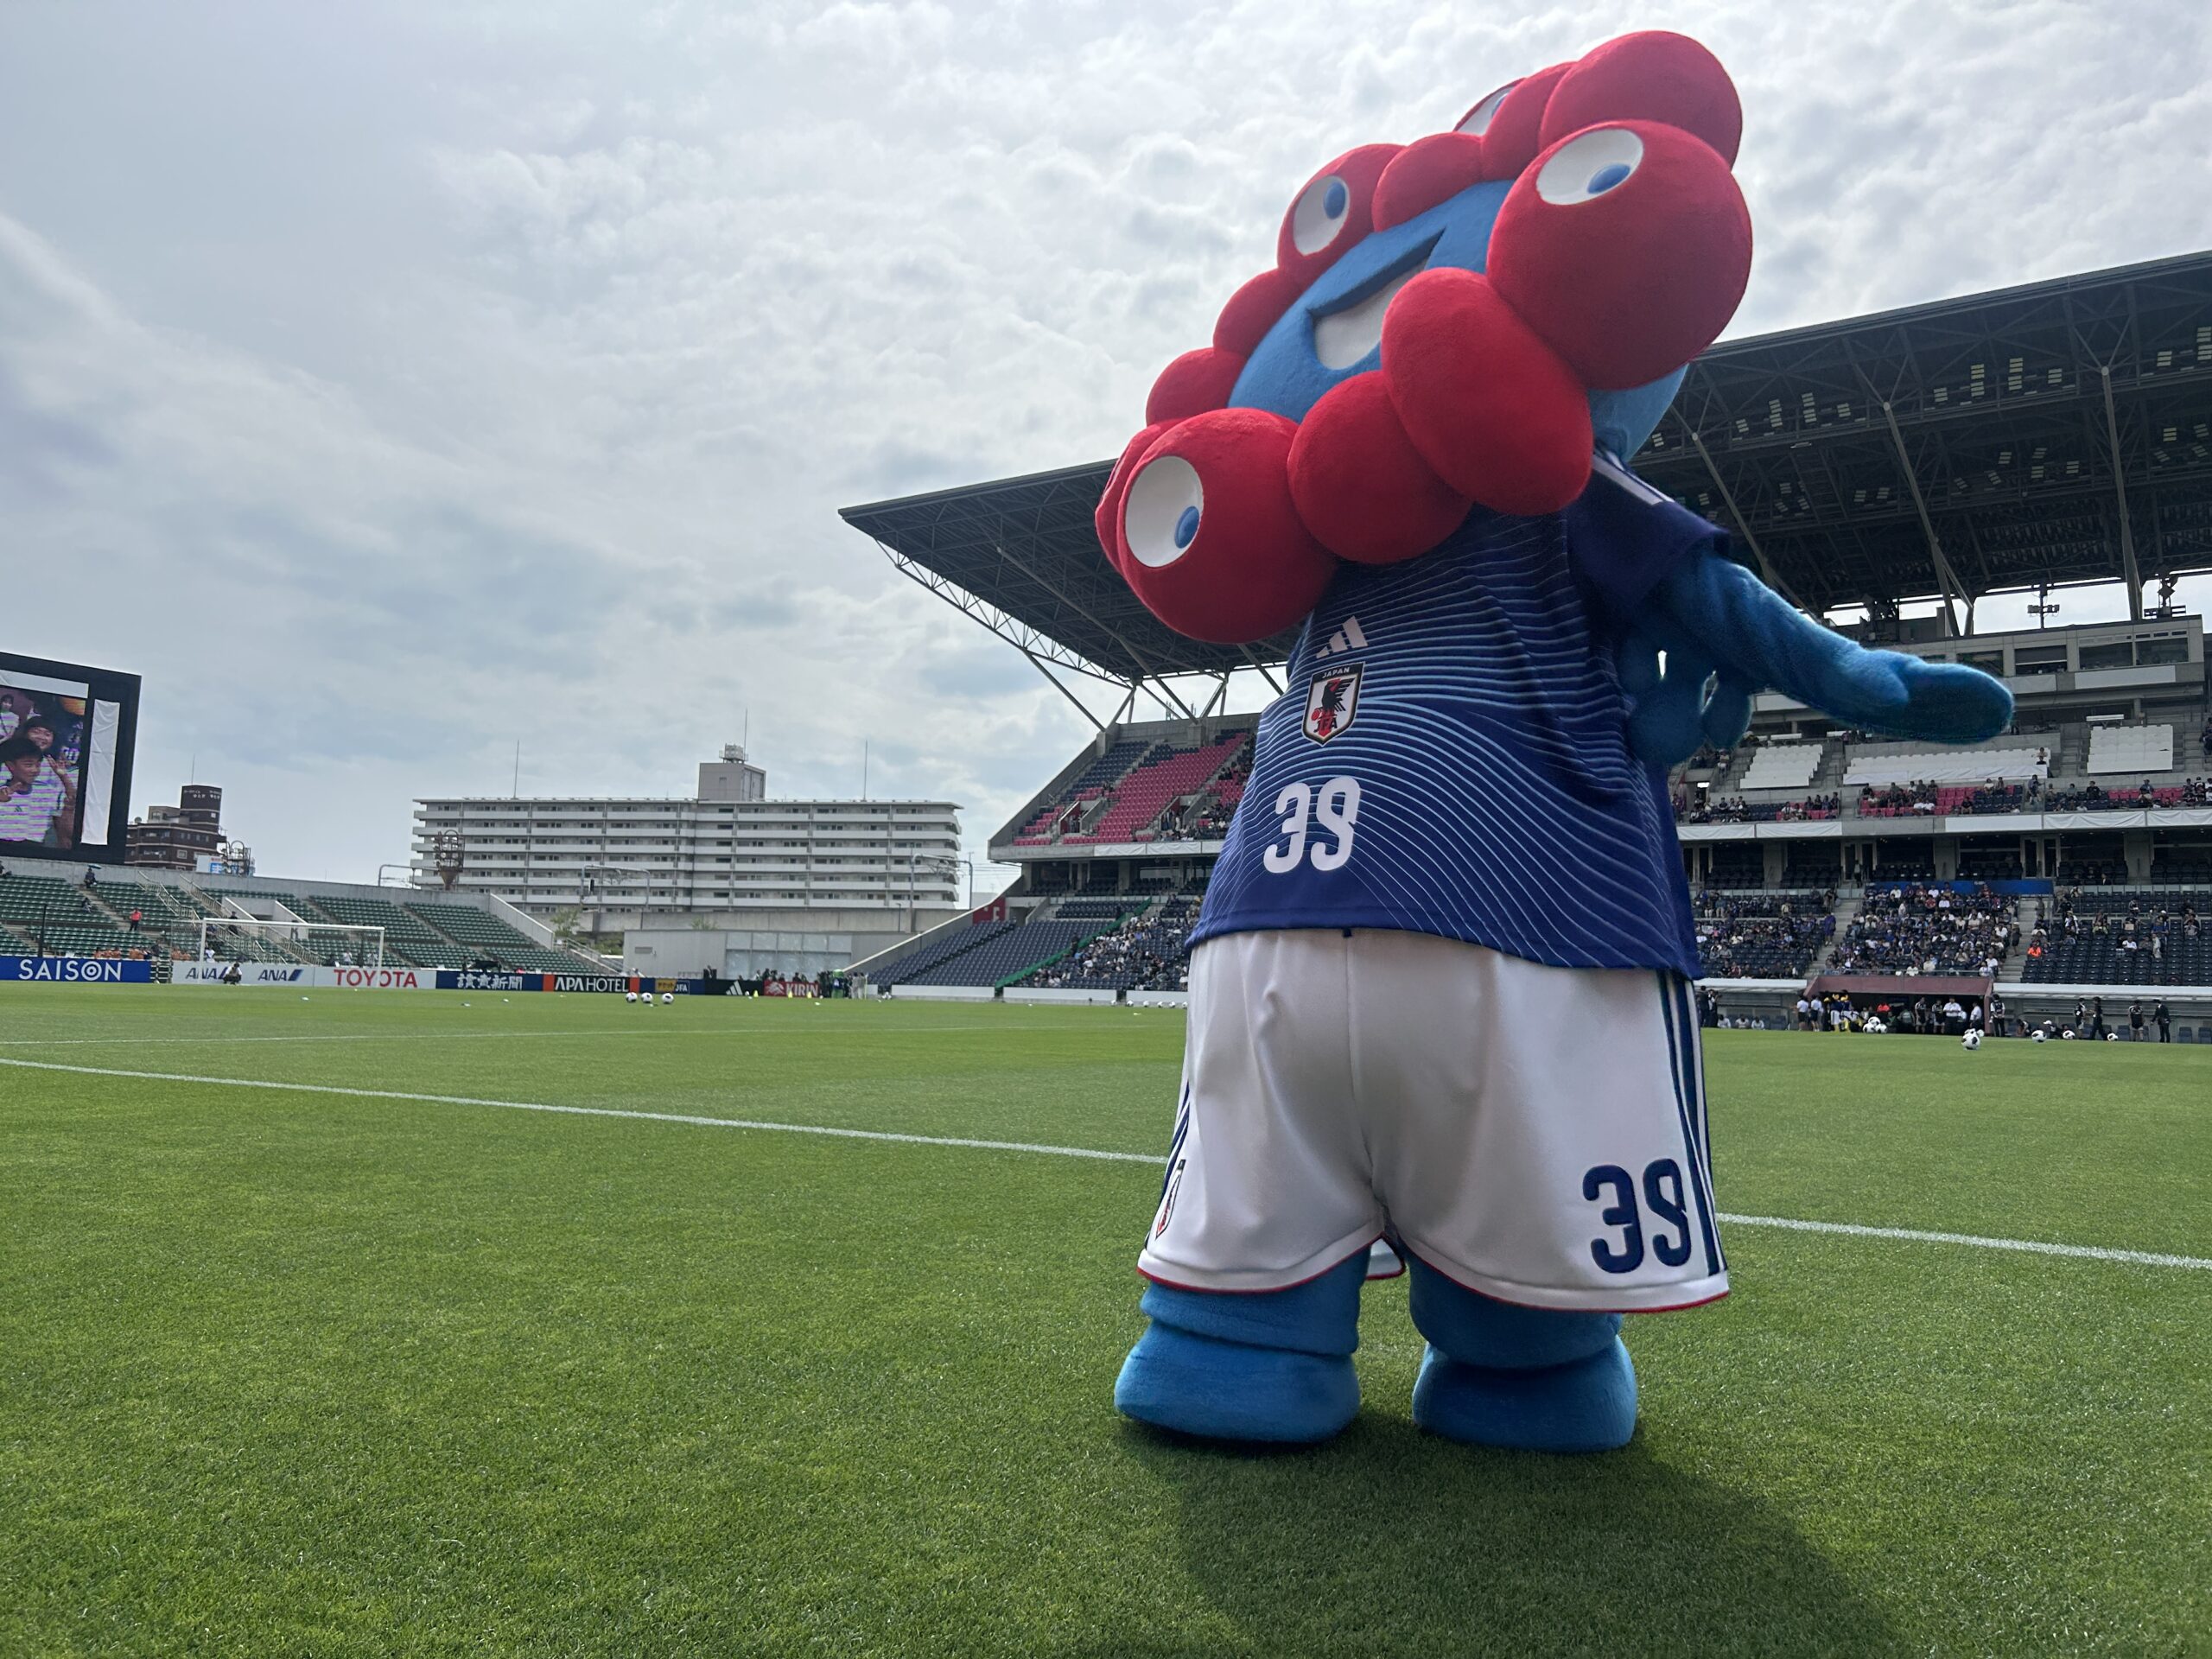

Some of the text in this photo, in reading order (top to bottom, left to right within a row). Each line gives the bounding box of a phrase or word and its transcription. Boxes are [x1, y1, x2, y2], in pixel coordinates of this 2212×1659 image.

[1322, 667, 1350, 678] JAPAN
[1313, 716, 1338, 733] JFA
[1263, 776, 1361, 874] 39
[18, 959, 122, 981] SAISON
[185, 967, 218, 980] ANA
[257, 969, 288, 982] ANA
[334, 969, 418, 988] TOYOTA
[555, 976, 629, 992] APA HOTEL
[675, 983, 688, 992] JFA
[785, 982, 818, 996] KIRIN
[1582, 1158, 1691, 1274] 39
